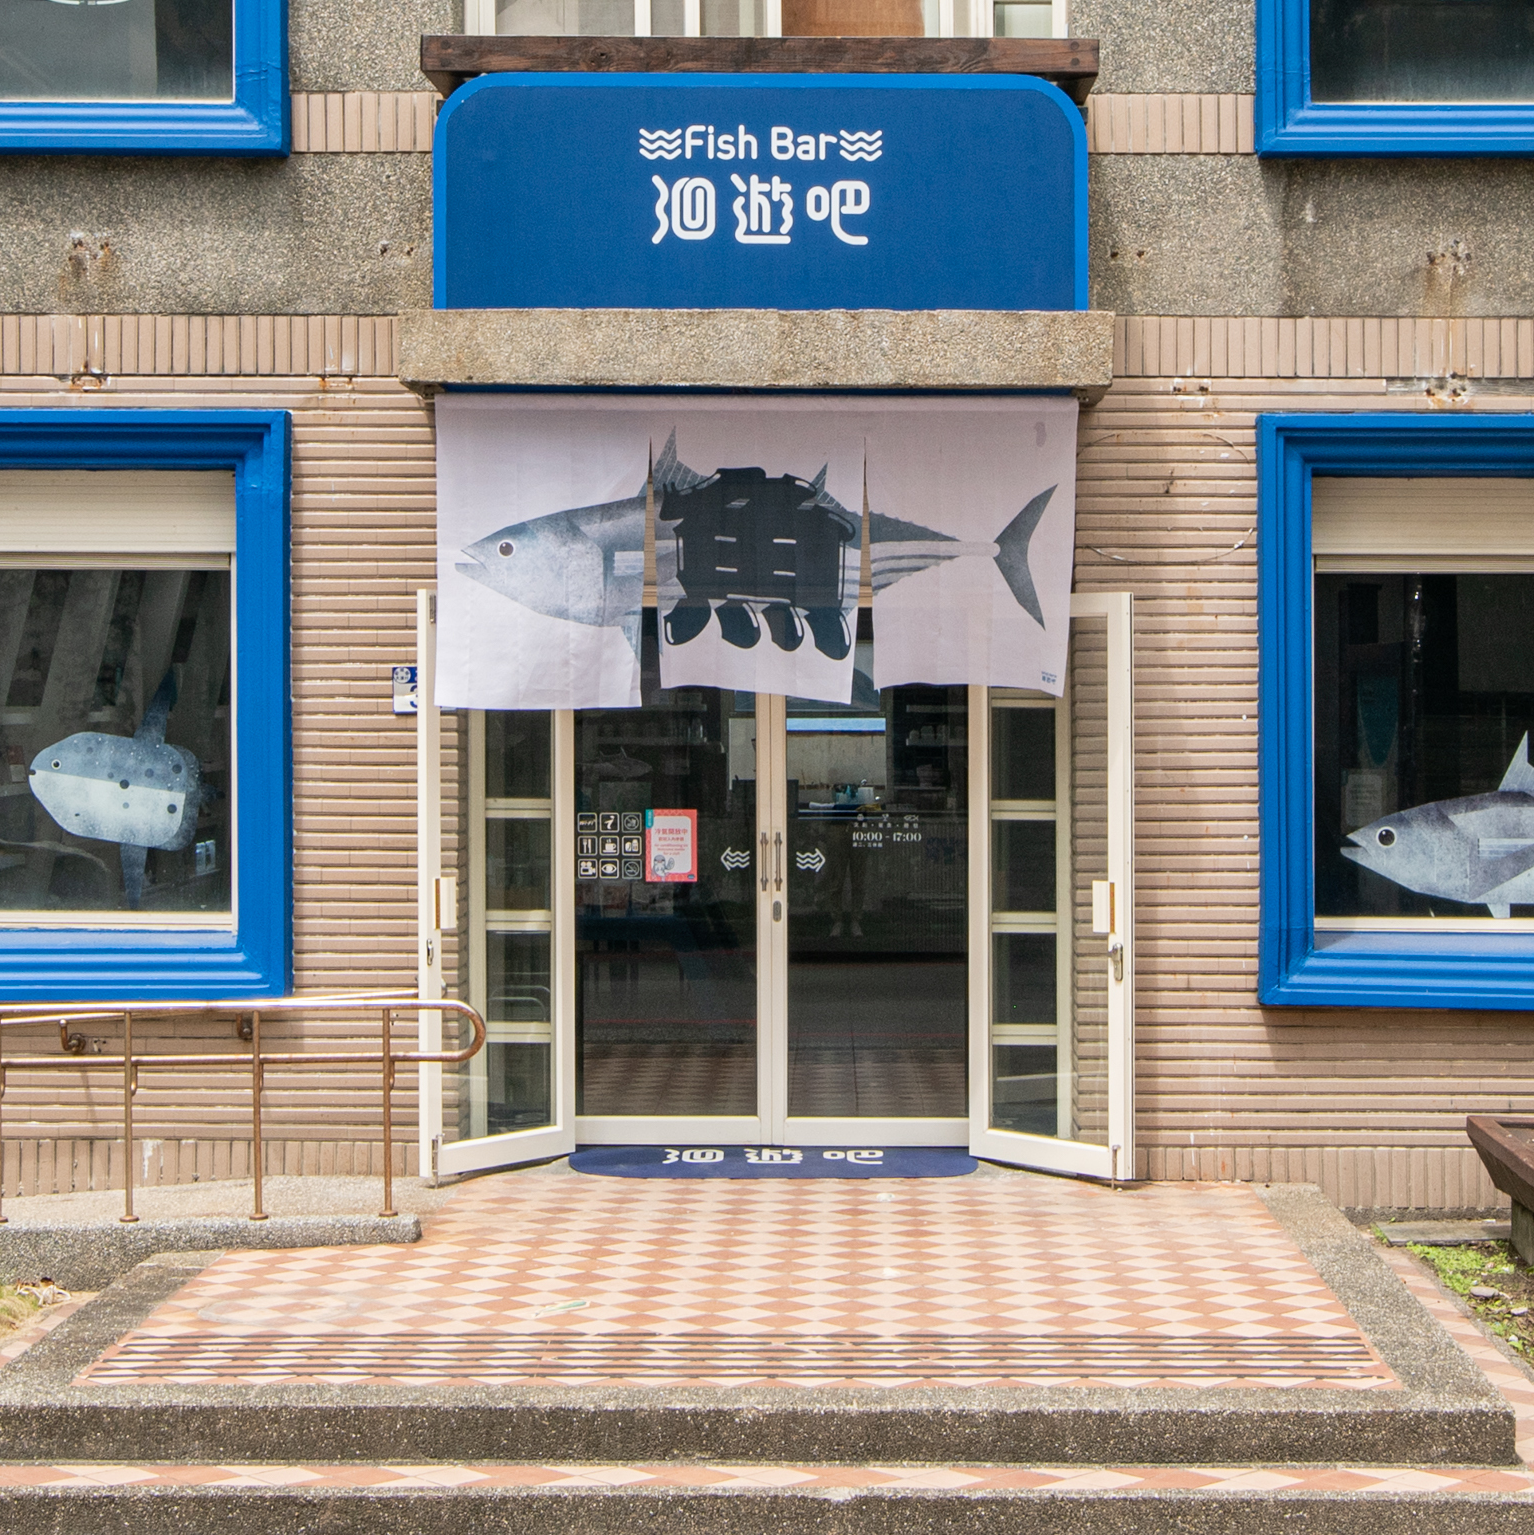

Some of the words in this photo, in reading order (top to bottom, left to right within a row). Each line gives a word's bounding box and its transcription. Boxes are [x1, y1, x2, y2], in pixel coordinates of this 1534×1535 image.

[685, 124, 758, 160] Fish
[771, 125, 838, 161] Bar
[651, 173, 870, 245] 洄遊吧
[852, 831, 883, 841] 10:00
[892, 832, 922, 842] 17:00
